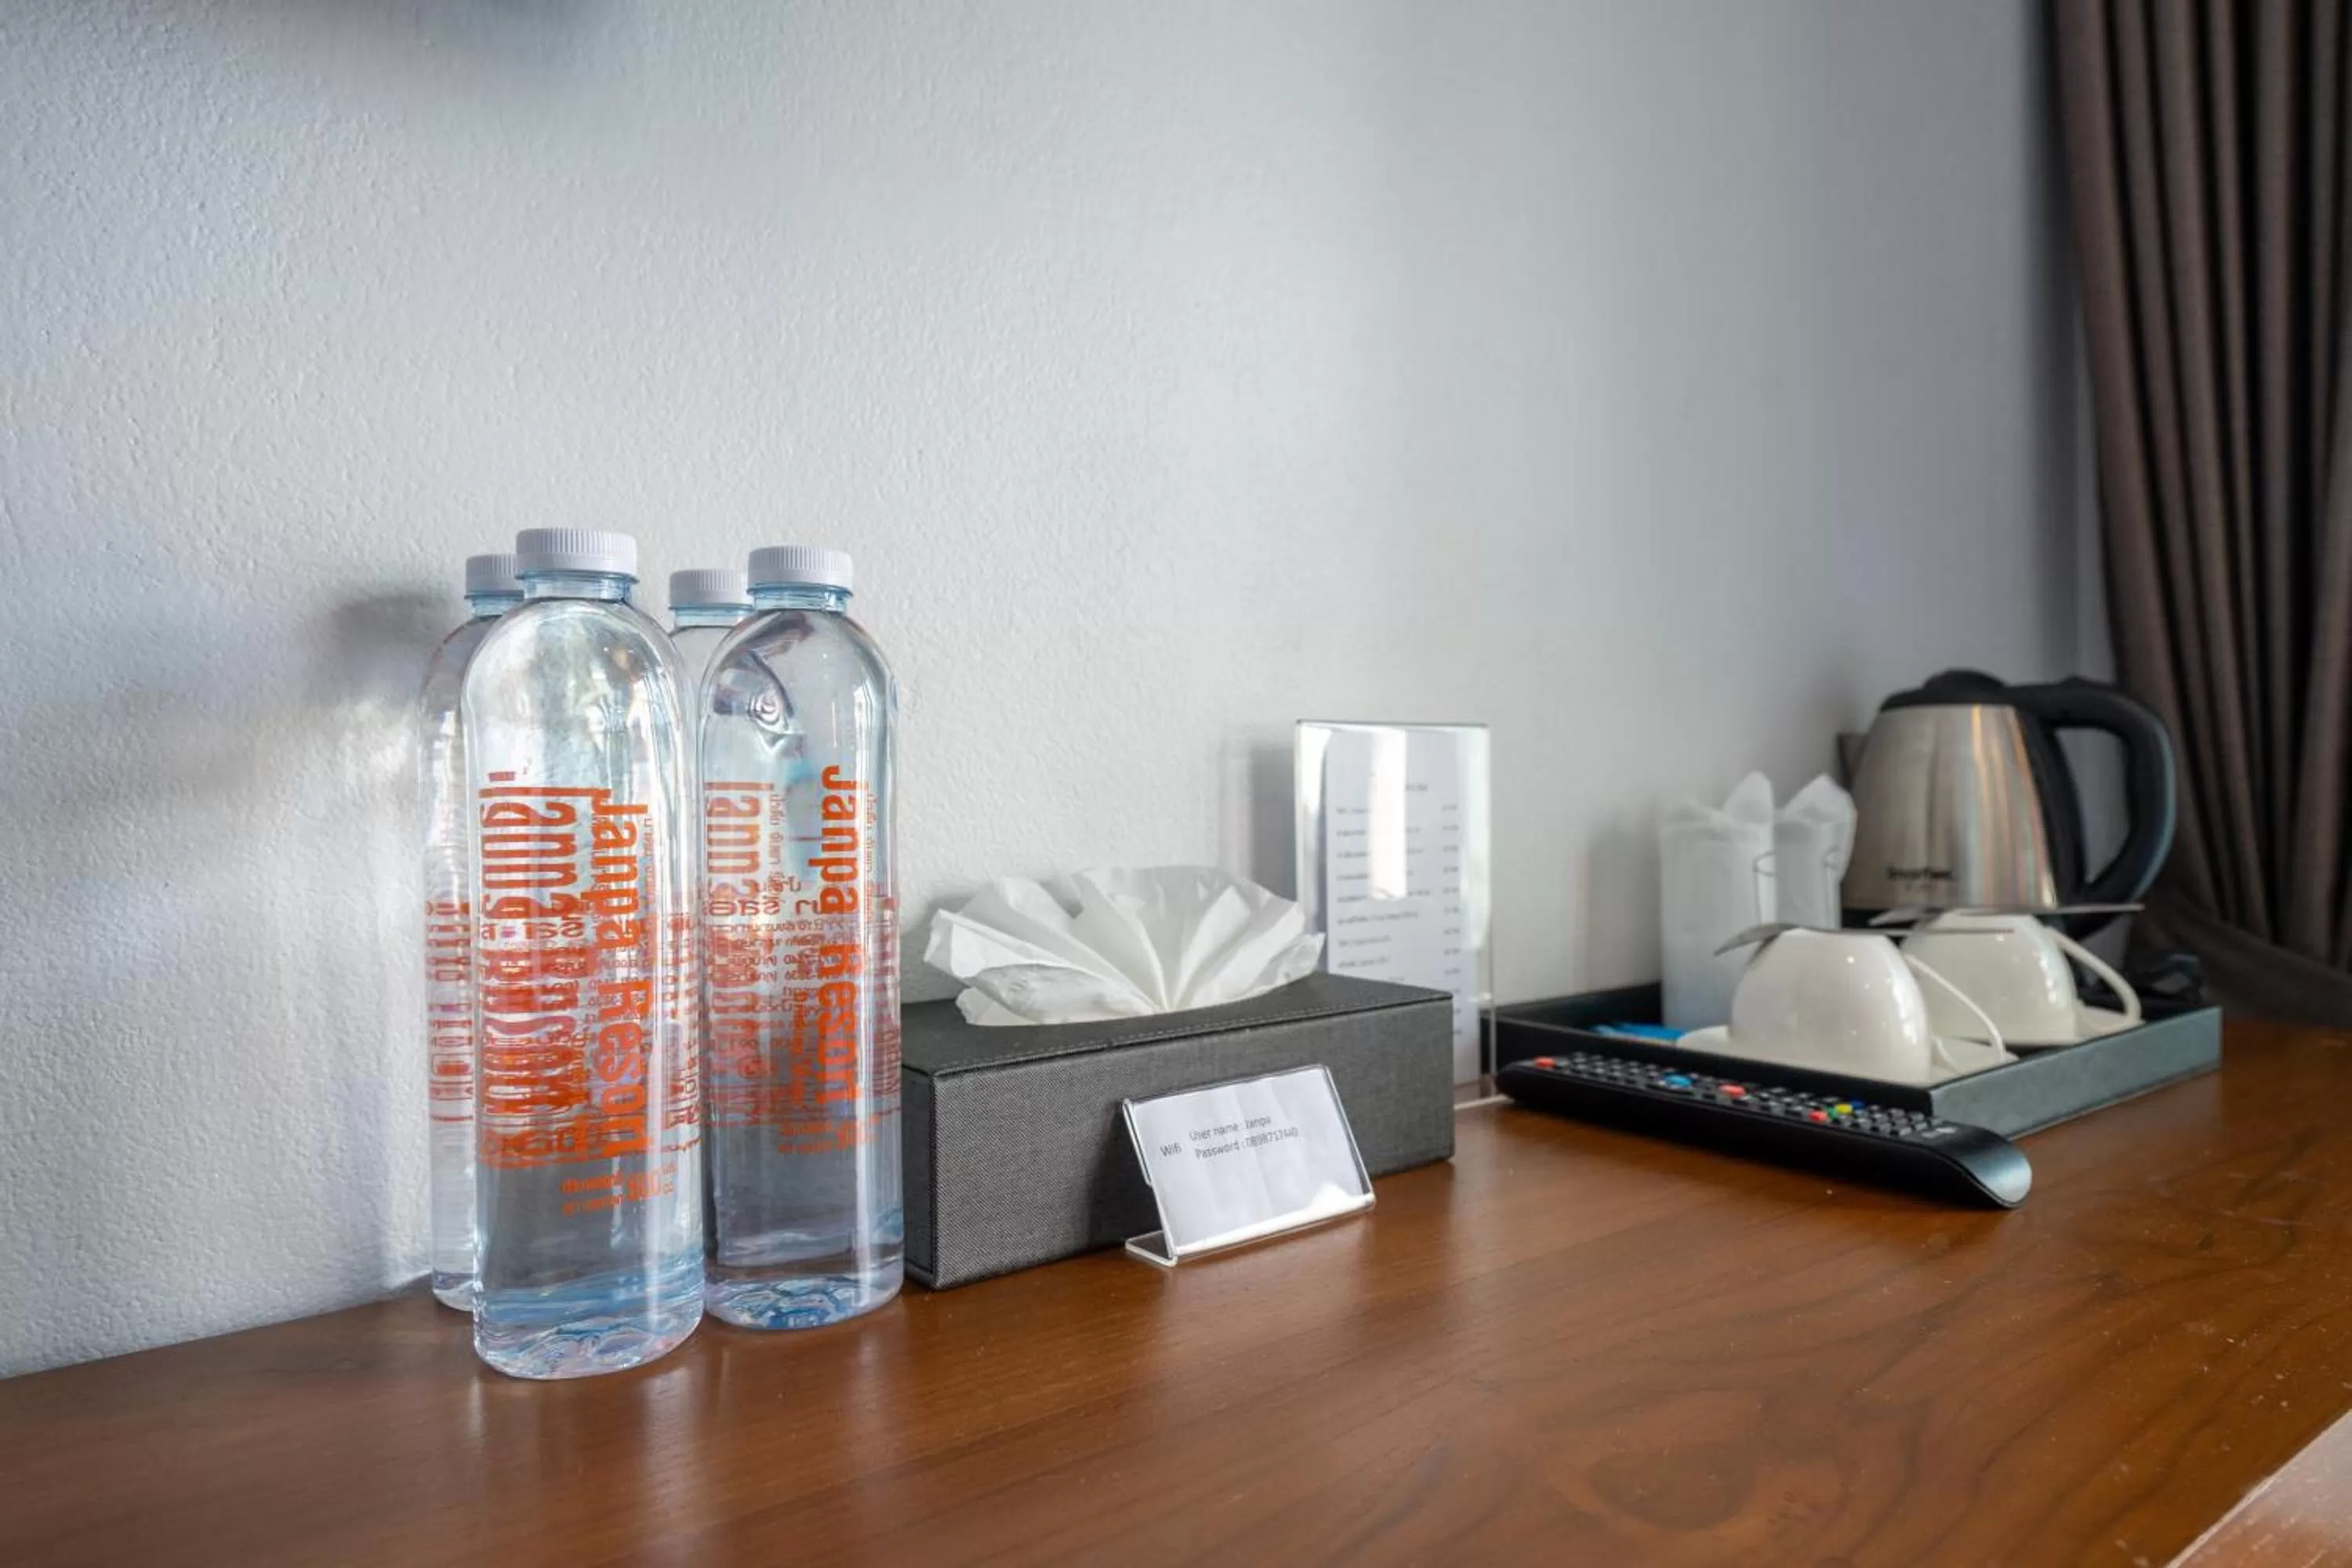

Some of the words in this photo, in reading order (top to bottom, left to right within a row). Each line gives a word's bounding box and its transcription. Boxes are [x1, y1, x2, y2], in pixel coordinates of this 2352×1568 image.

[580, 804, 649, 949] Janpa
[808, 764, 868, 914] Janpa
[1189, 1129, 1211, 1142] User
[1213, 1122, 1239, 1135] name
[1194, 1140, 1240, 1160] Password
